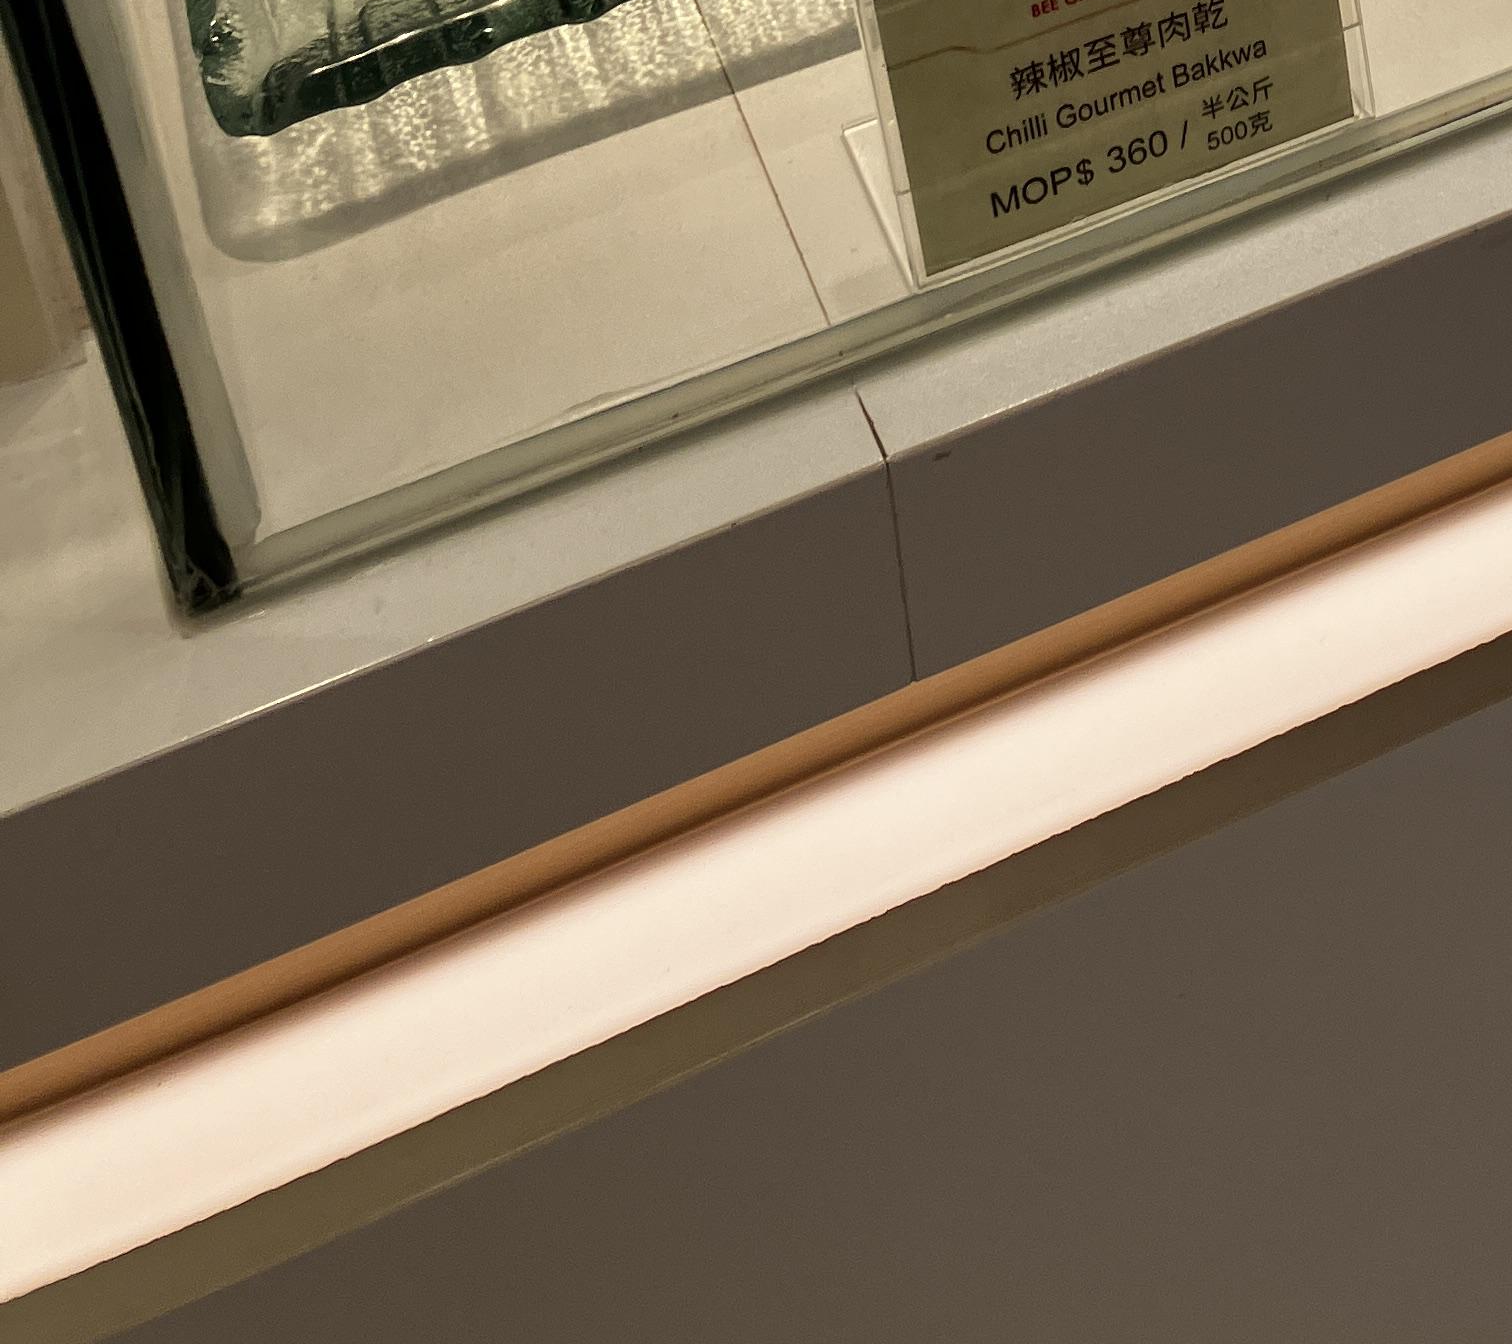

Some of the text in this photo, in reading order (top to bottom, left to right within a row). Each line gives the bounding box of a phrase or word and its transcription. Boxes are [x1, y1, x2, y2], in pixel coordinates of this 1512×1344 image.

[985, 38, 1268, 155] Chilli Gourmet Bakkwa
[1200, 76, 1275, 120] 半公斤
[1206, 110, 1275, 151] 500克
[990, 158, 1096, 218] MOP$
[1106, 130, 1169, 175] 360
